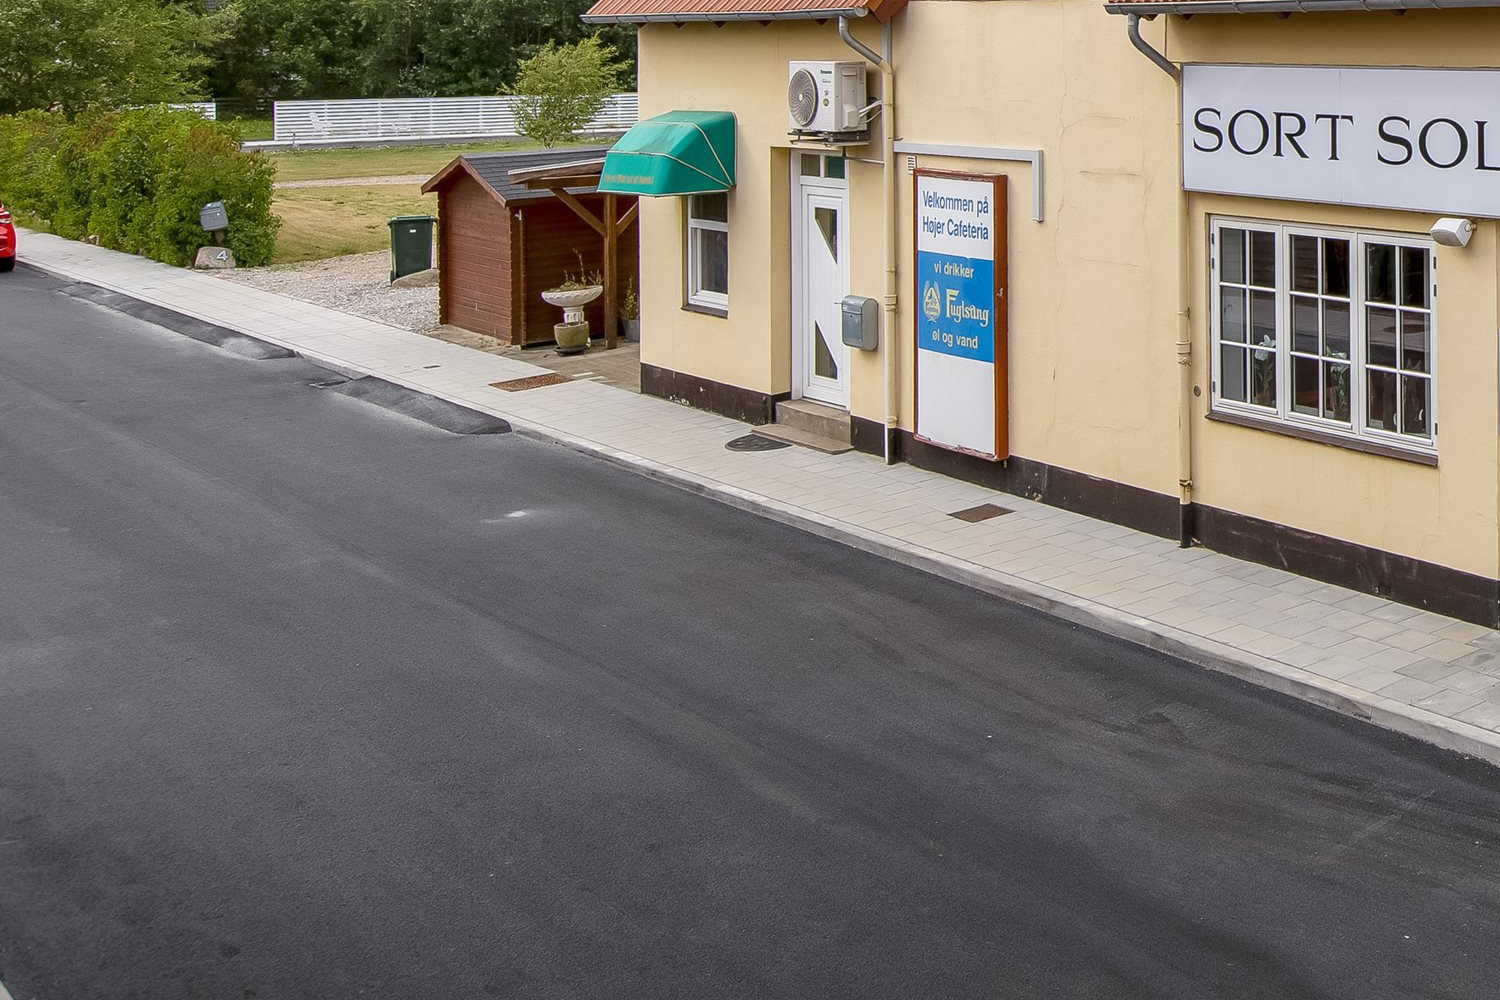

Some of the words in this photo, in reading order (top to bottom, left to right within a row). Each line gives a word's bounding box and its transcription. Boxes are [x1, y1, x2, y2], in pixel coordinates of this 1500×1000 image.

[1193, 107, 1354, 161] SORT
[922, 190, 974, 212] Velkommen
[976, 196, 989, 218] på
[922, 216, 945, 238] Højer
[947, 218, 989, 240] Cafeteria
[216, 250, 228, 262] 4
[934, 261, 942, 274] vi
[943, 262, 975, 279] drikker
[945, 288, 990, 328] Fuglsang
[932, 328, 940, 342] øl
[942, 332, 954, 348] og
[956, 336, 978, 350] vand
